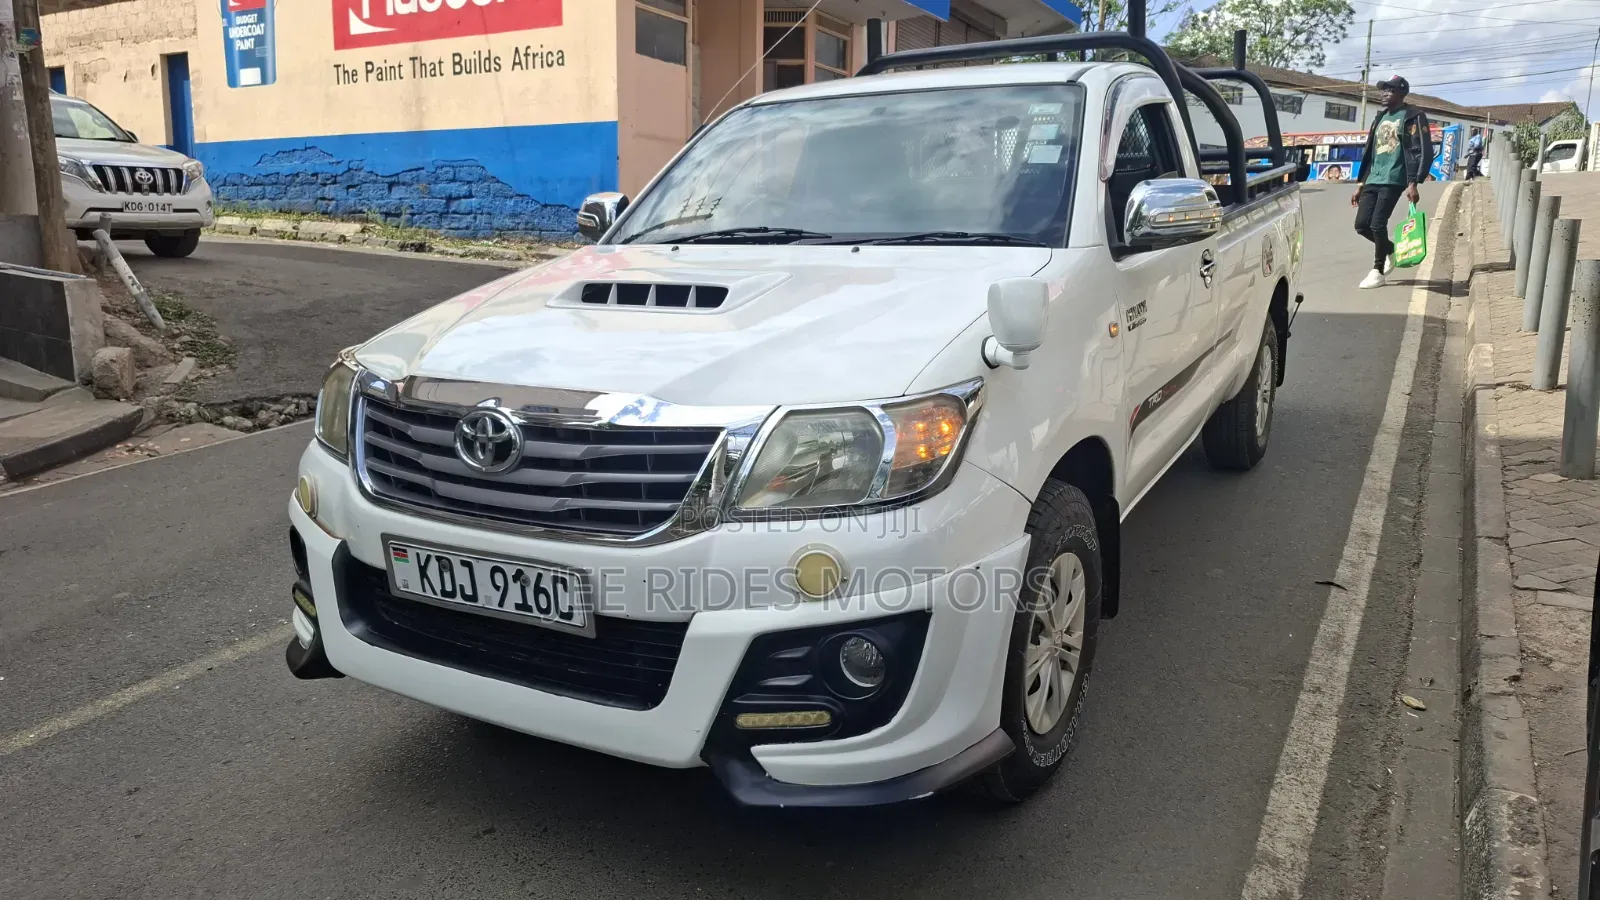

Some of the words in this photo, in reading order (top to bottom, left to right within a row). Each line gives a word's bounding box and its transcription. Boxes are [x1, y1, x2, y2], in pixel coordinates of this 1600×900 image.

[236, 14, 257, 25] BUDGET
[229, 23, 264, 38] UNDERCOAT
[236, 38, 254, 50] PAINT
[333, 63, 359, 86] The
[365, 59, 404, 83] Paint
[409, 55, 445, 79] That
[452, 49, 501, 76] Builds
[511, 44, 565, 72] Africa
[416, 551, 479, 603] KDJ
[489, 564, 574, 621] 916C
